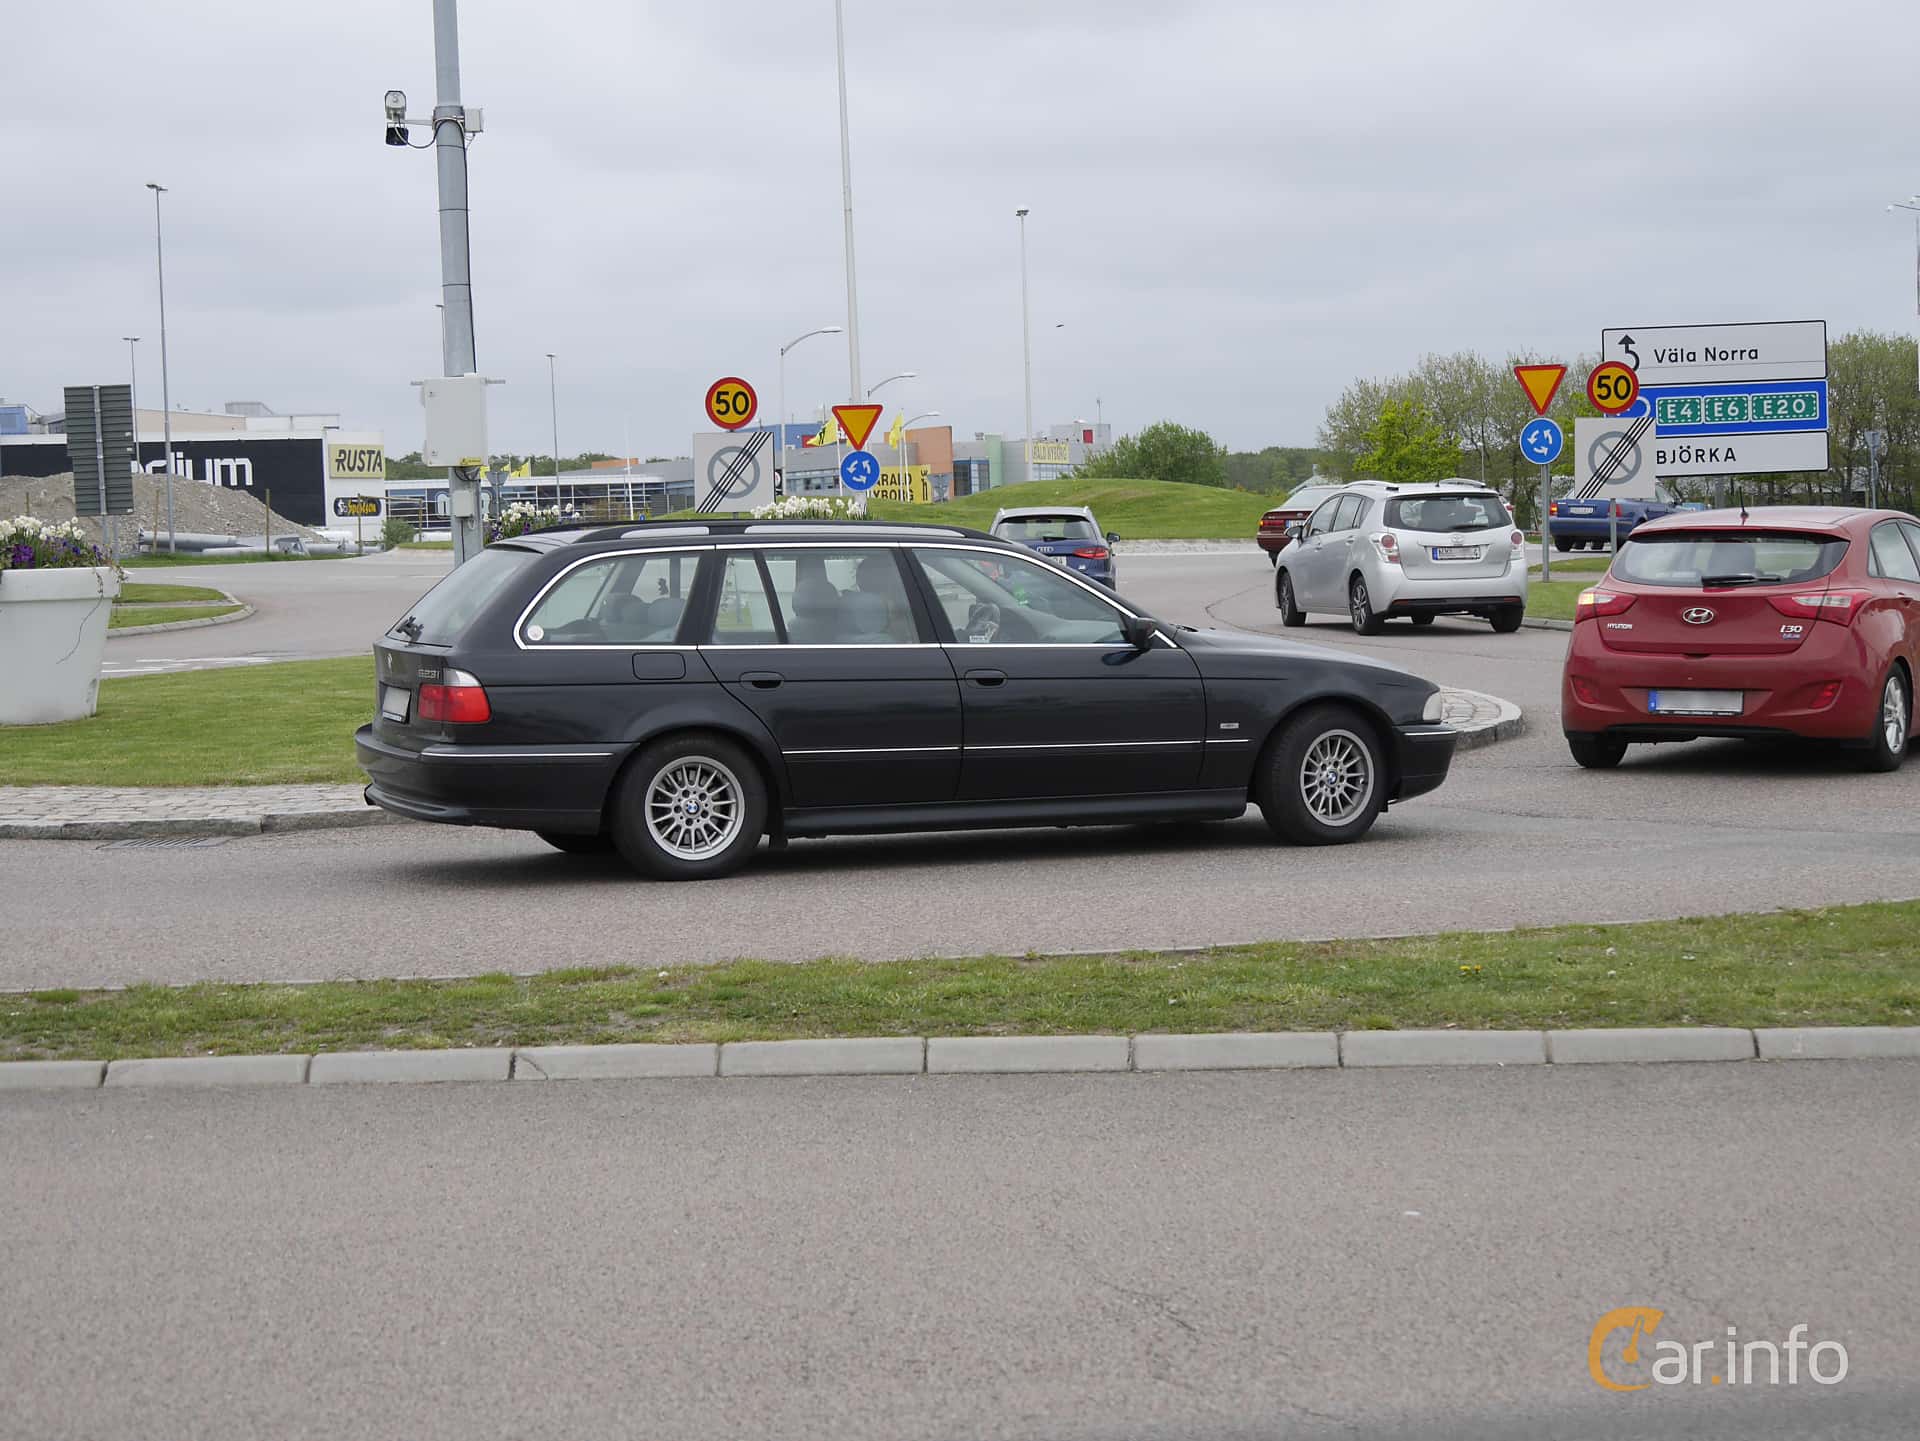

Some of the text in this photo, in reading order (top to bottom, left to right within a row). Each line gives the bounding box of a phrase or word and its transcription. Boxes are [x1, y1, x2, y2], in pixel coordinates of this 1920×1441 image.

[1653, 346, 1759, 364] Väla Norra
[1596, 374, 1632, 401] 50
[715, 390, 750, 416] 50
[1666, 398, 1806, 419] E4 E6 E20
[335, 448, 383, 473] RUSTA
[1655, 445, 1737, 465] BJÖRKA
